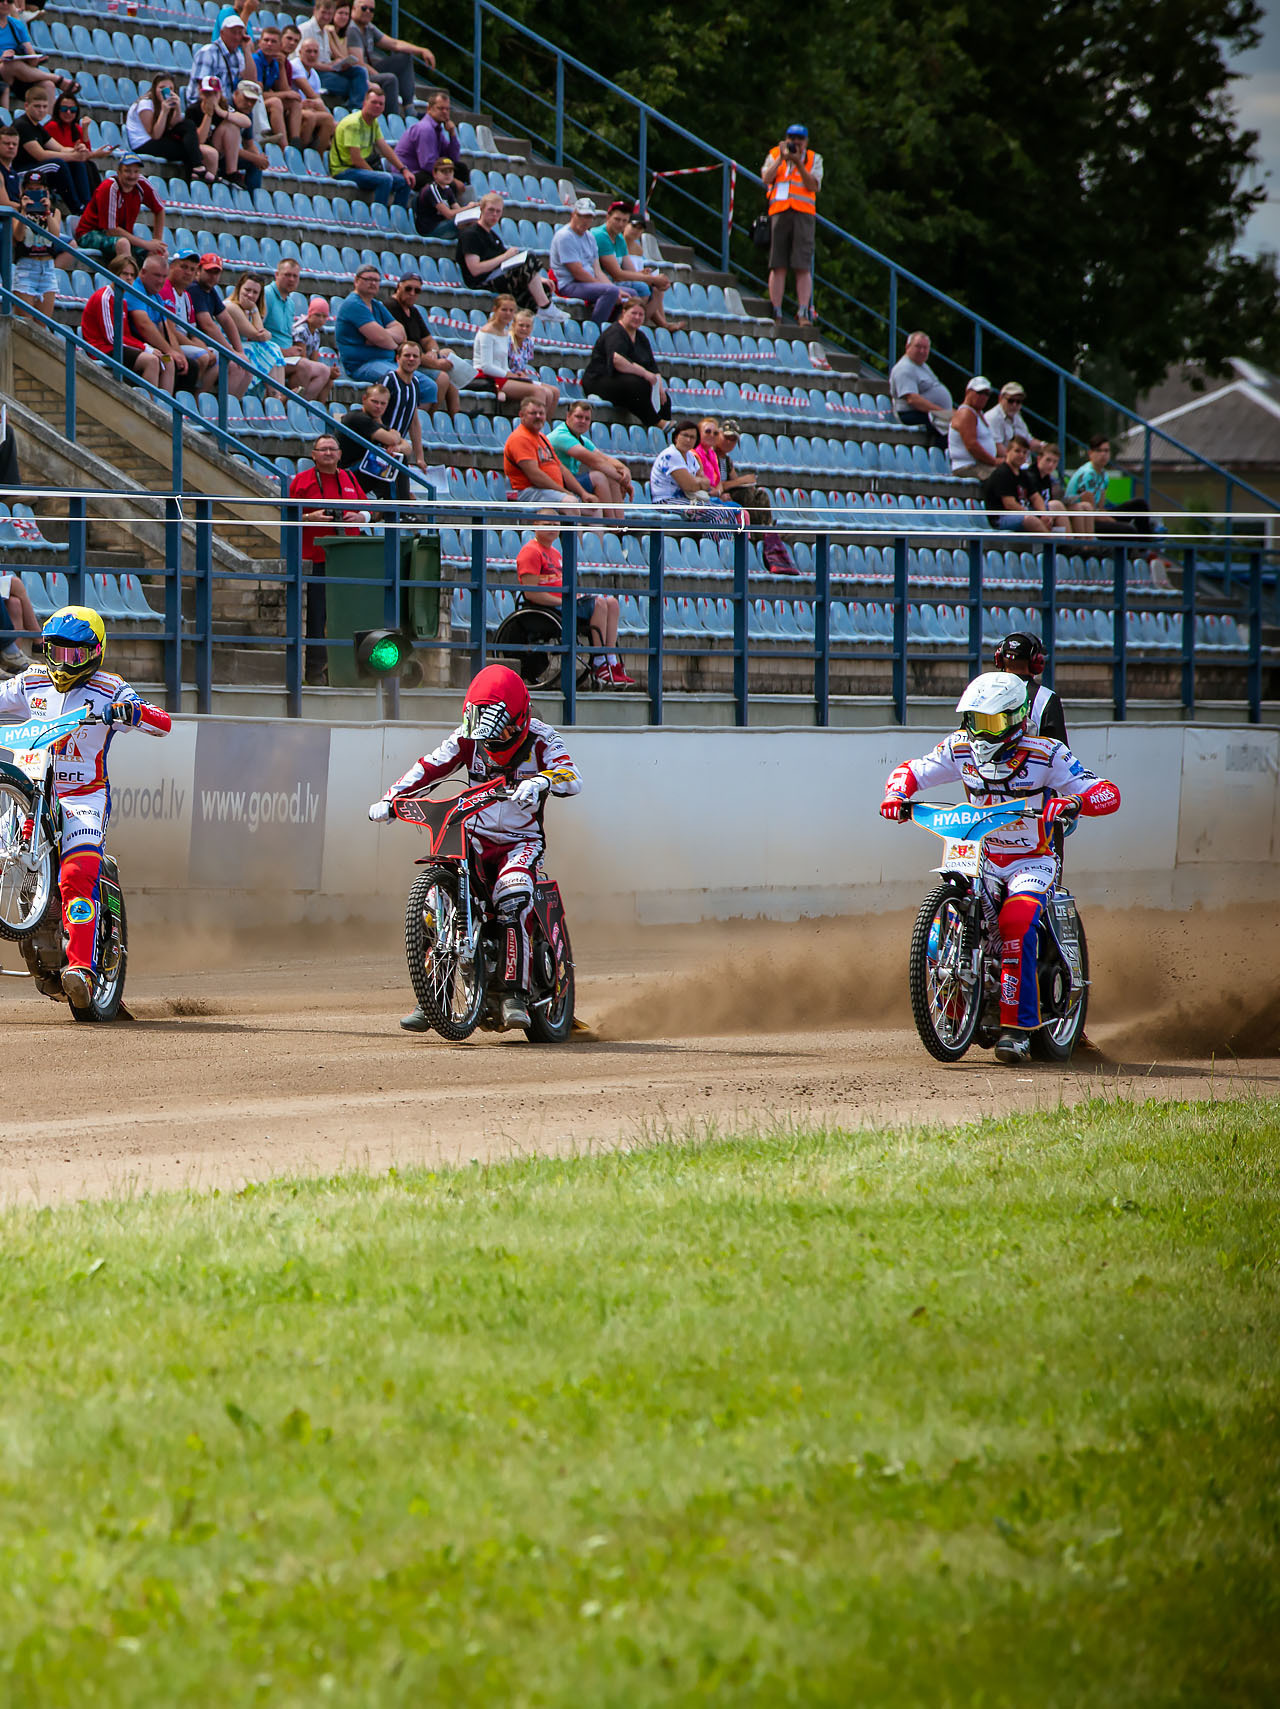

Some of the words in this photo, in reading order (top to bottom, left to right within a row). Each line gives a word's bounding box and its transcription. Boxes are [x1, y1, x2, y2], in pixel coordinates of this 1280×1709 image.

[5, 721, 59, 743] HYABAK
[73, 728, 89, 740] 45
[110, 778, 185, 828] gorod.lv
[201, 782, 320, 832] www.gorod.lv
[933, 811, 994, 827] HYABAK
